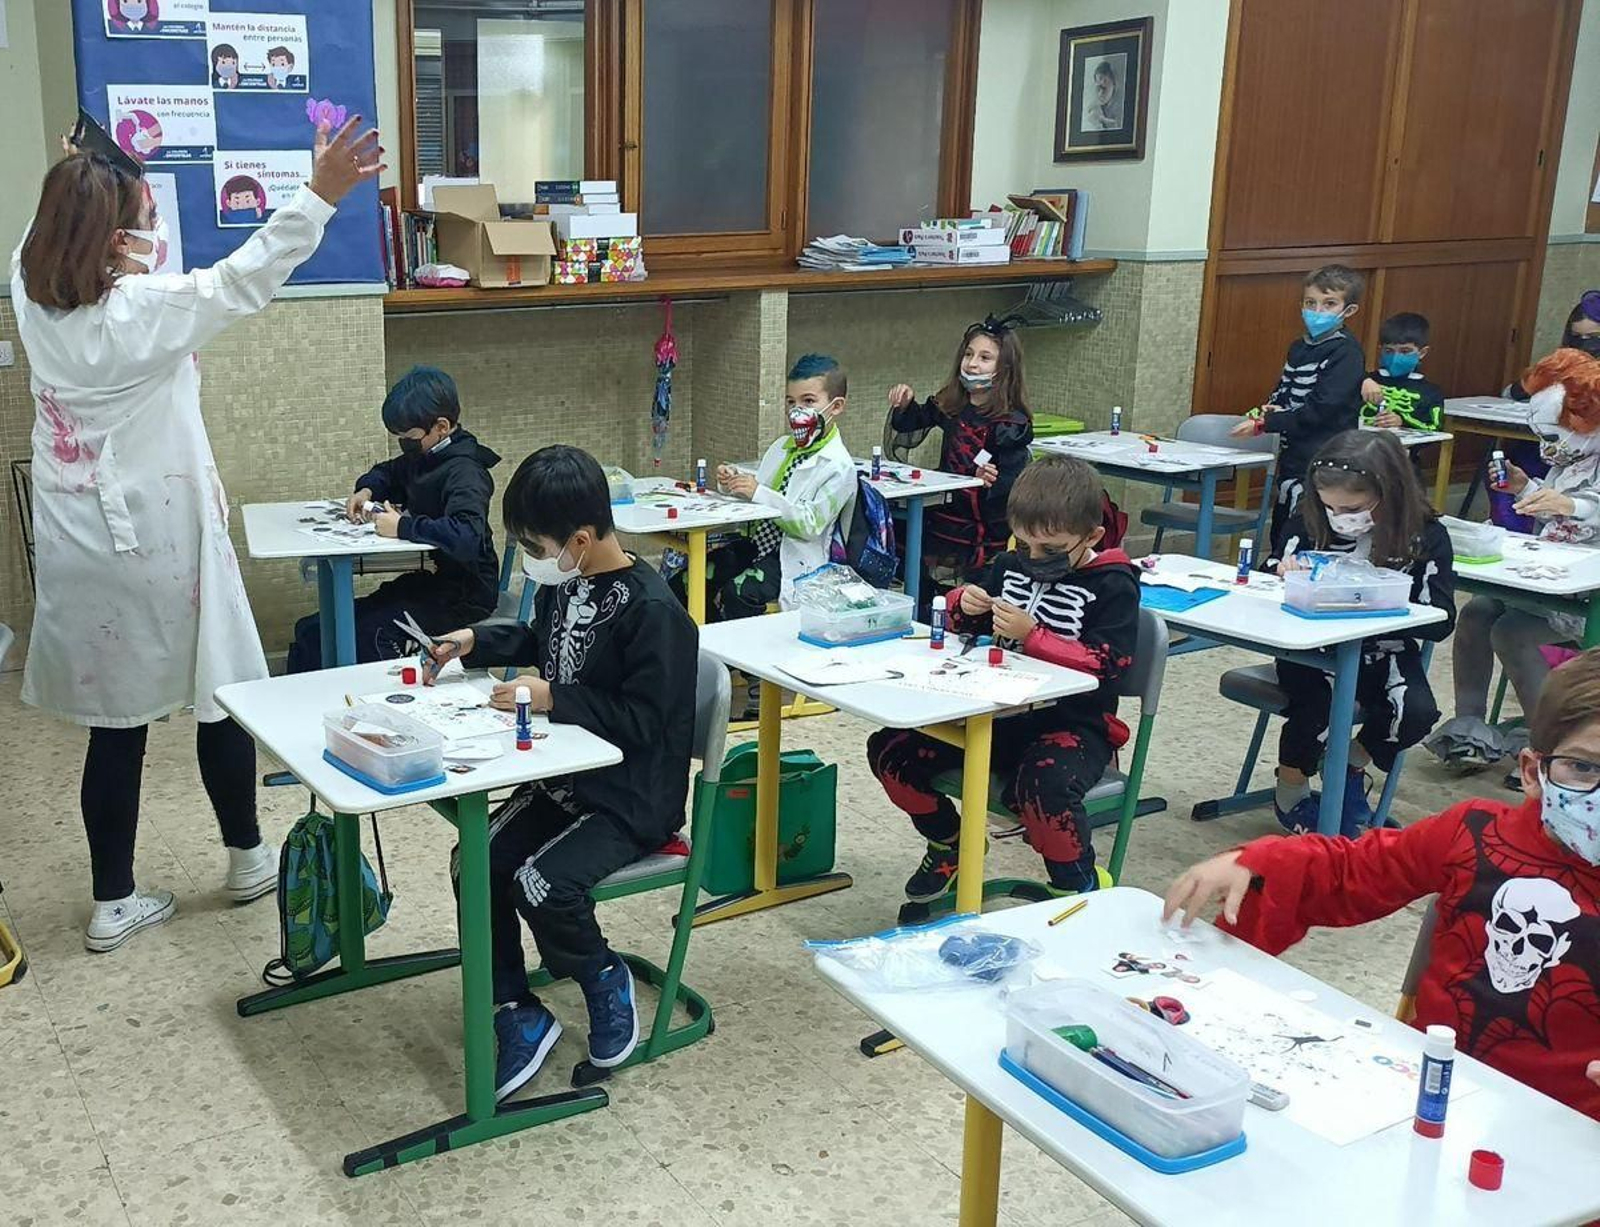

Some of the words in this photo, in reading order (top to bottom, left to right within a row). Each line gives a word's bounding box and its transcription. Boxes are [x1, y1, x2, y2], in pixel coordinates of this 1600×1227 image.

[247, 23, 256, 32] la
[256, 24, 296, 33] distancia
[243, 34, 265, 42] entre
[267, 35, 303, 43] personas
[117, 96, 155, 106] Lávate
[156, 96, 172, 106] las
[173, 97, 209, 106] manos
[170, 110, 211, 119] frecuencia
[235, 161, 267, 170] tienes
[1353, 592, 1362, 604] 3
